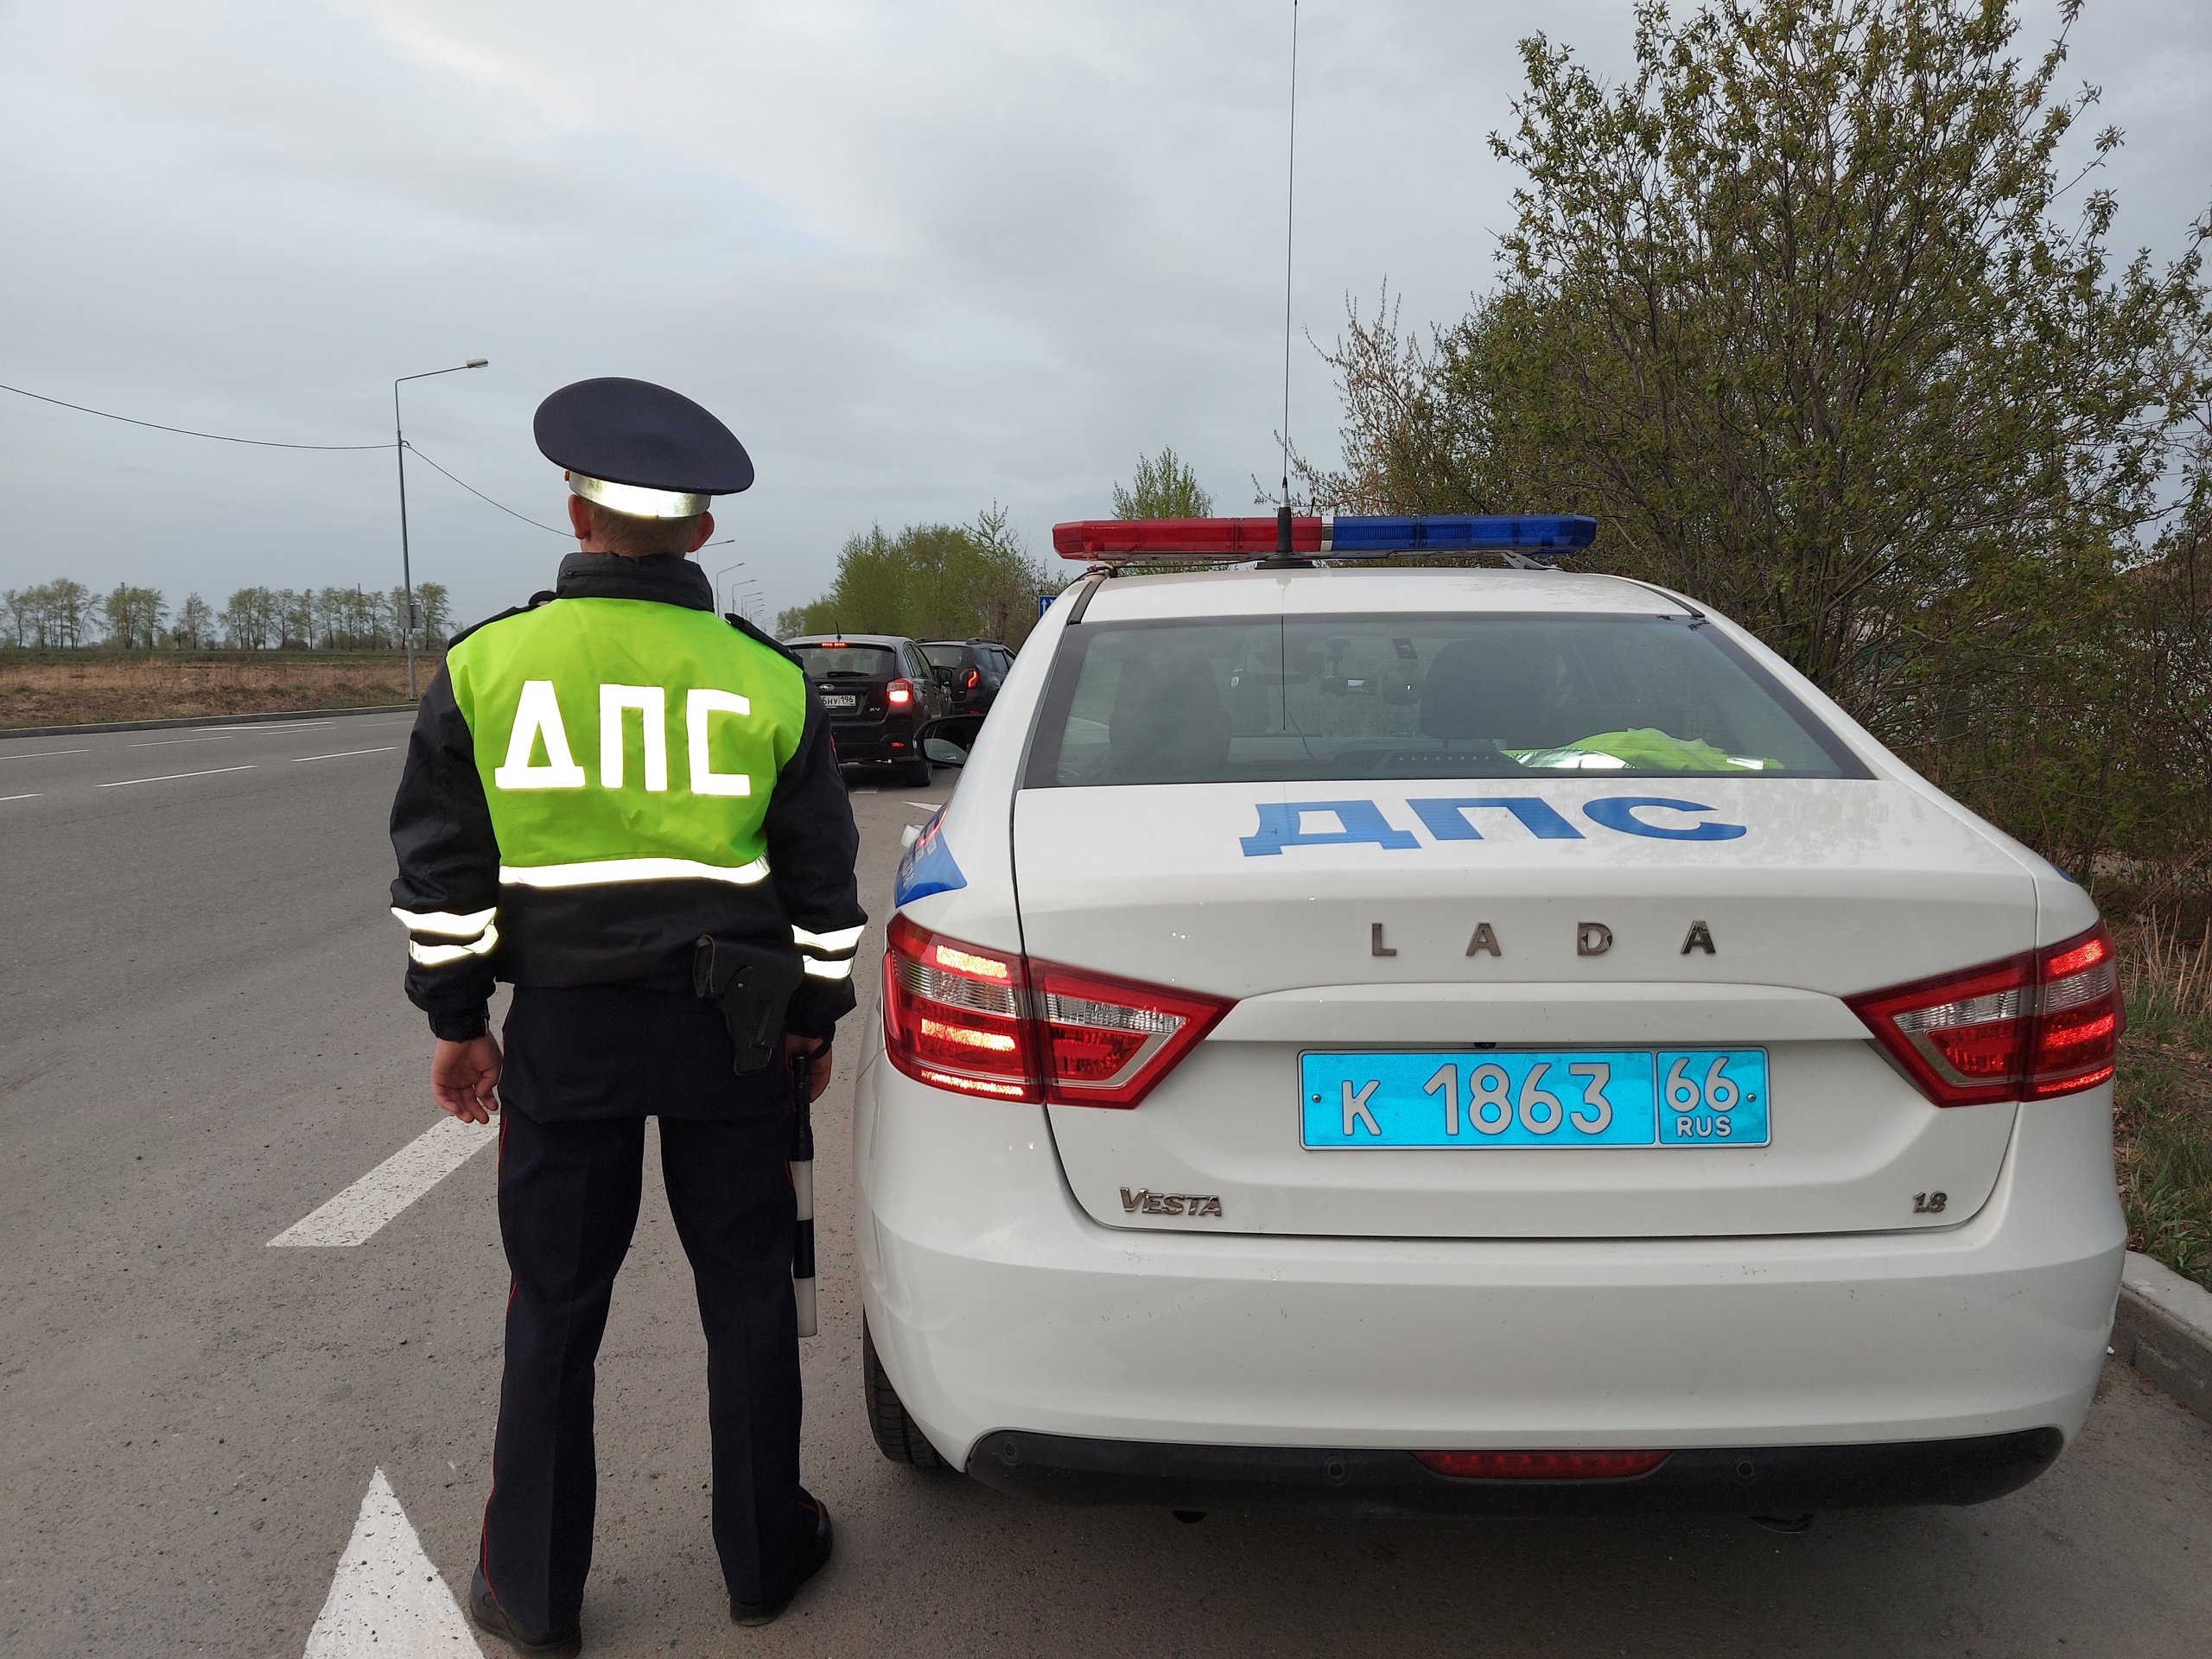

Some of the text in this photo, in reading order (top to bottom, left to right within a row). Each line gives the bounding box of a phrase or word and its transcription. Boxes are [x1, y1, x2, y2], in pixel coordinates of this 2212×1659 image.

[822, 696, 838, 705] 6НУ
[494, 680, 751, 796] ДПС
[1239, 797, 1747, 857] ДПС
[1371, 920, 1717, 957] LADA
[1421, 1062, 1613, 1136] 1863
[1664, 1056, 1740, 1113] 66
[1675, 1115, 1732, 1138] RUS
[1120, 1187, 1222, 1217] VESTA
